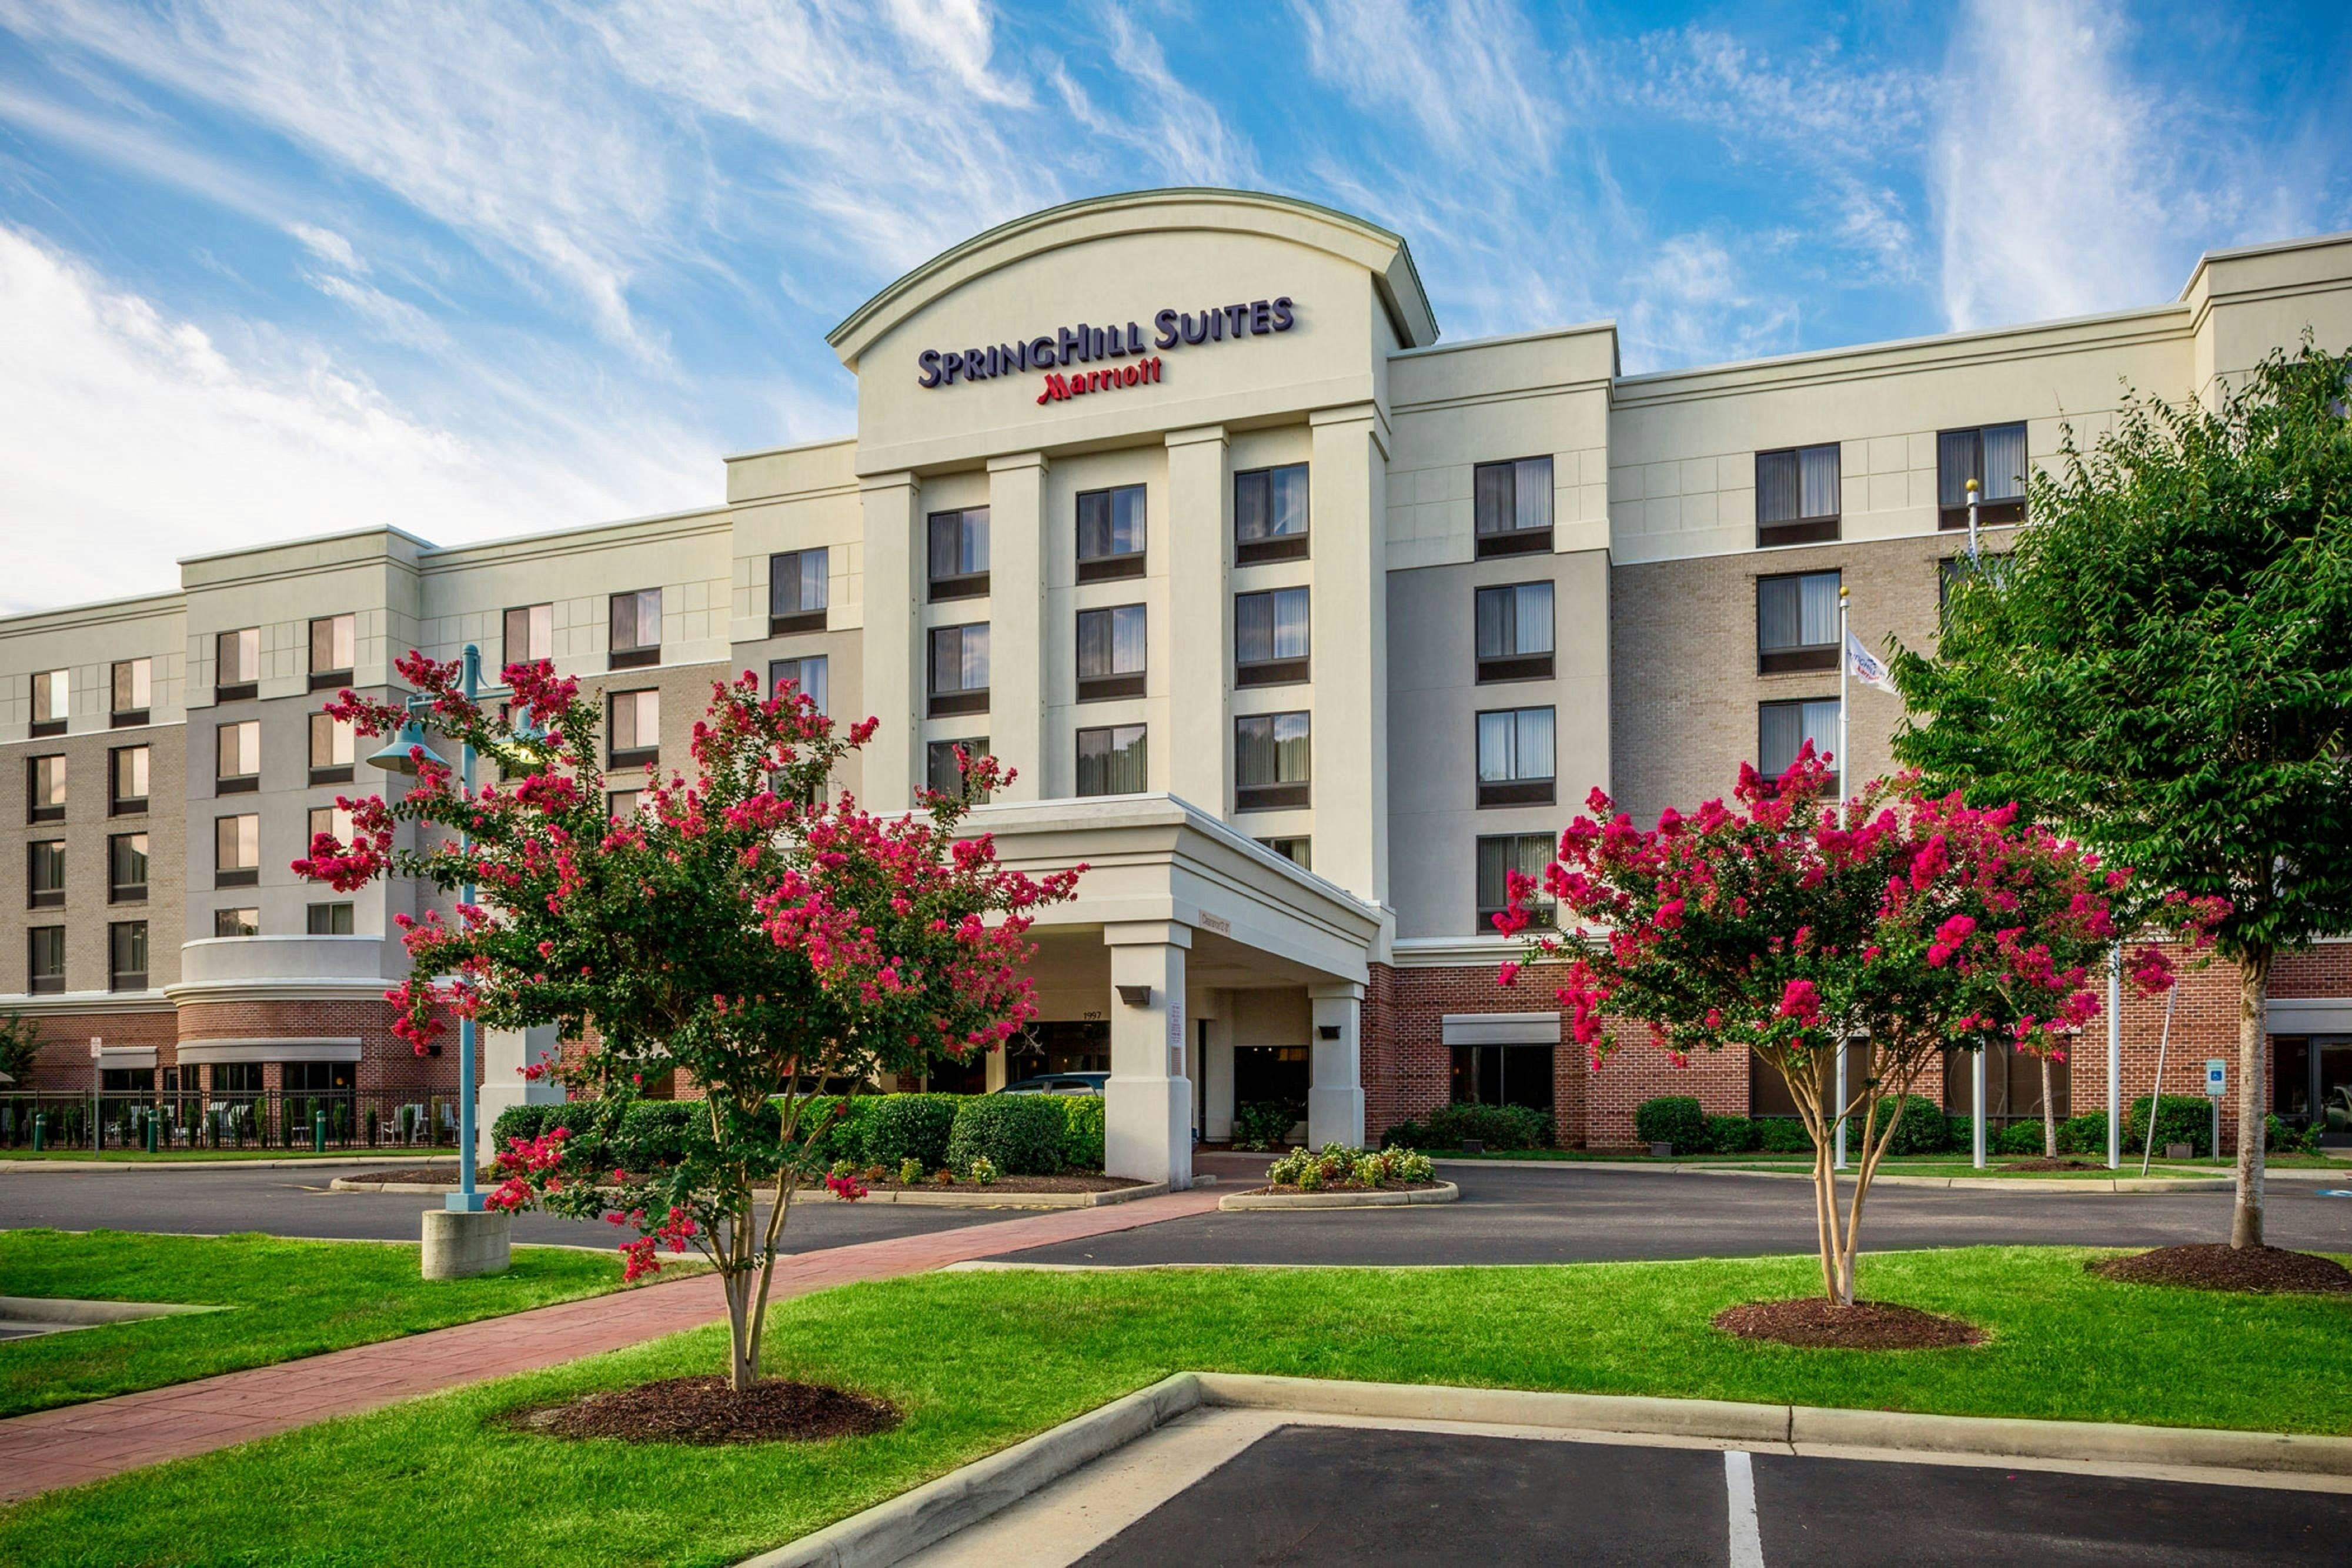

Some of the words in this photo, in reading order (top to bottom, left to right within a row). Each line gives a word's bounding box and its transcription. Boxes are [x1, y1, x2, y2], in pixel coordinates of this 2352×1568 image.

[918, 321, 1146, 388] SPRINGHILL
[1154, 296, 1294, 349] SUITES
[1036, 356, 1162, 404] Marriott
[1084, 1011, 1101, 1020] 1997
